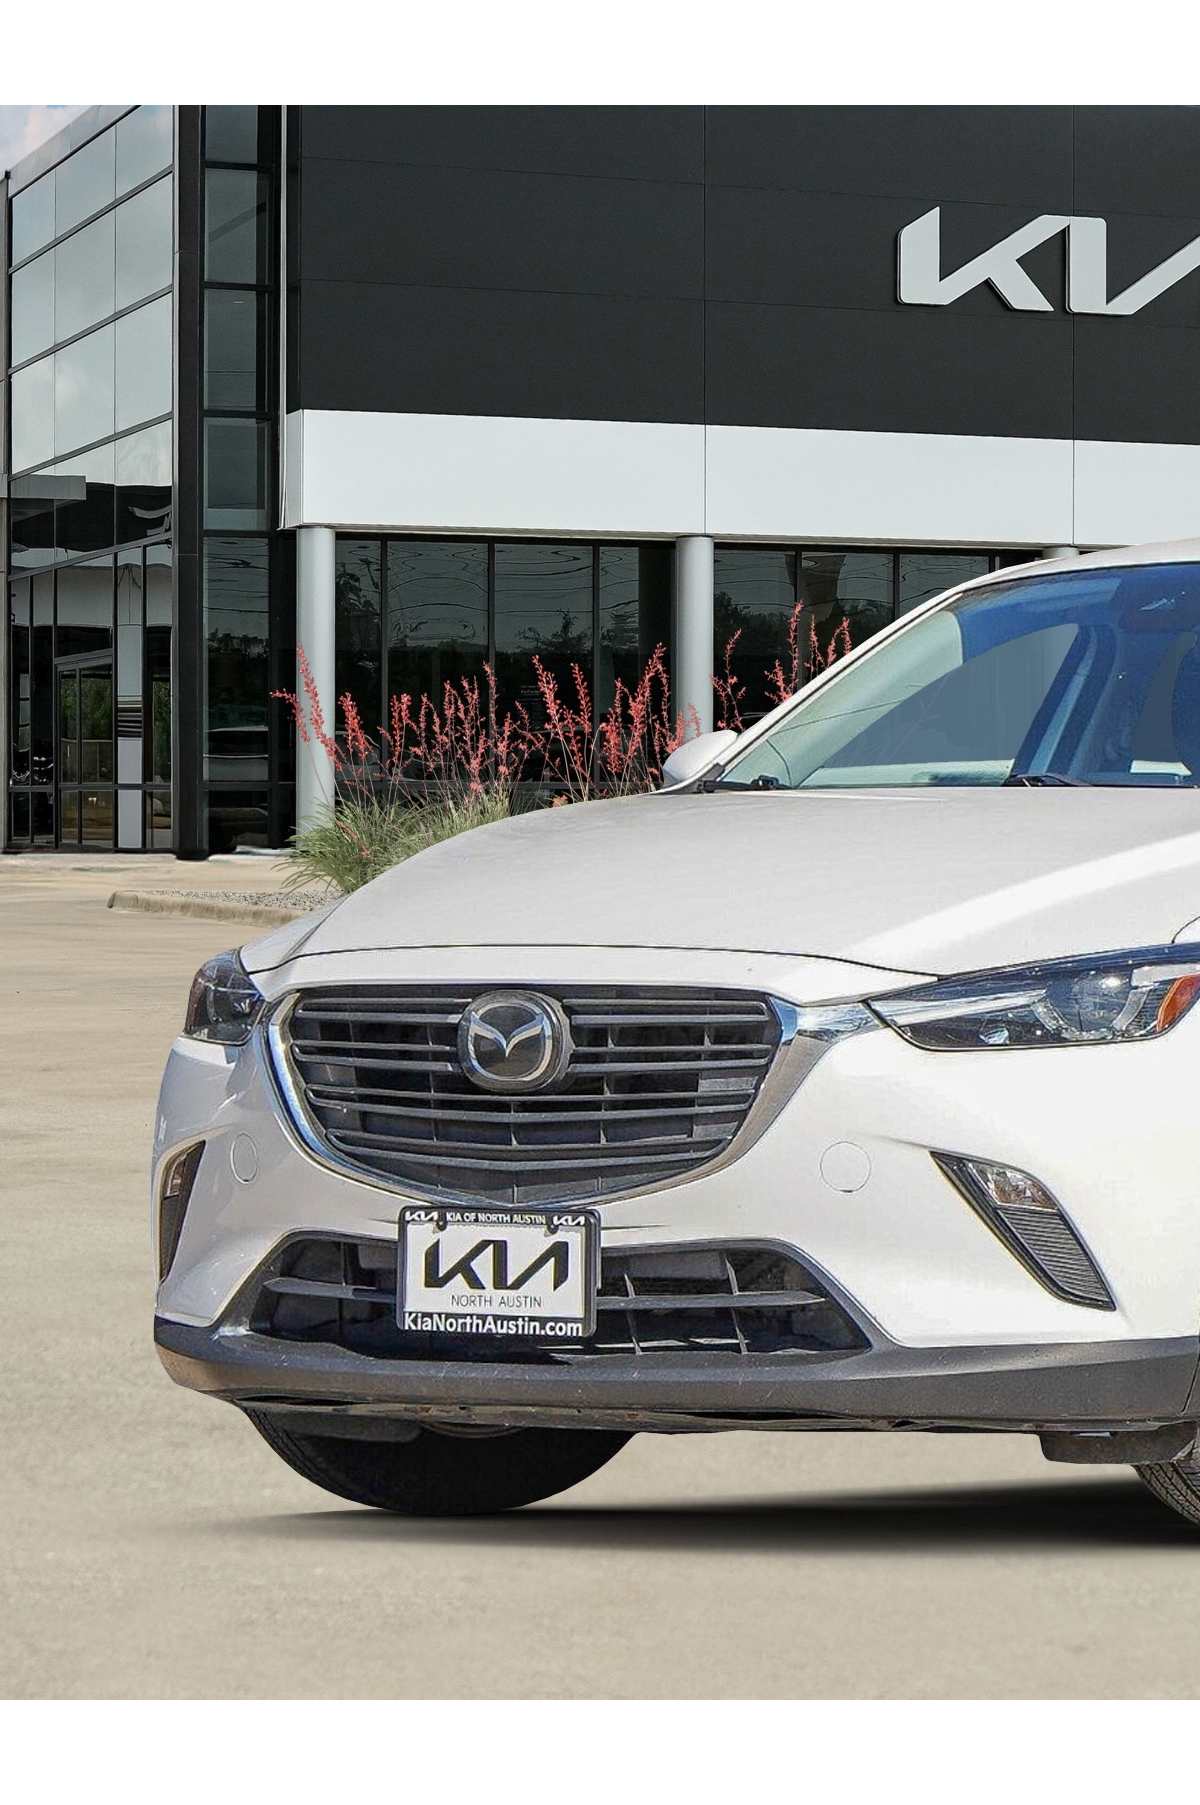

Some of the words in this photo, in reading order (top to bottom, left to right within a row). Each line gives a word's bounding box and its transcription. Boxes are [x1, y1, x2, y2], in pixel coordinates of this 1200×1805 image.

[446, 1212, 463, 1222] KIA
[464, 1213, 477, 1223] OF
[478, 1213, 511, 1224] NORTH
[512, 1214, 546, 1225] AUSTIN
[424, 1238, 569, 1292] KIA
[451, 1295, 493, 1307] NORTH
[499, 1296, 542, 1309] AUSTIN
[404, 1312, 583, 1337] KiaNorthAustin.com
